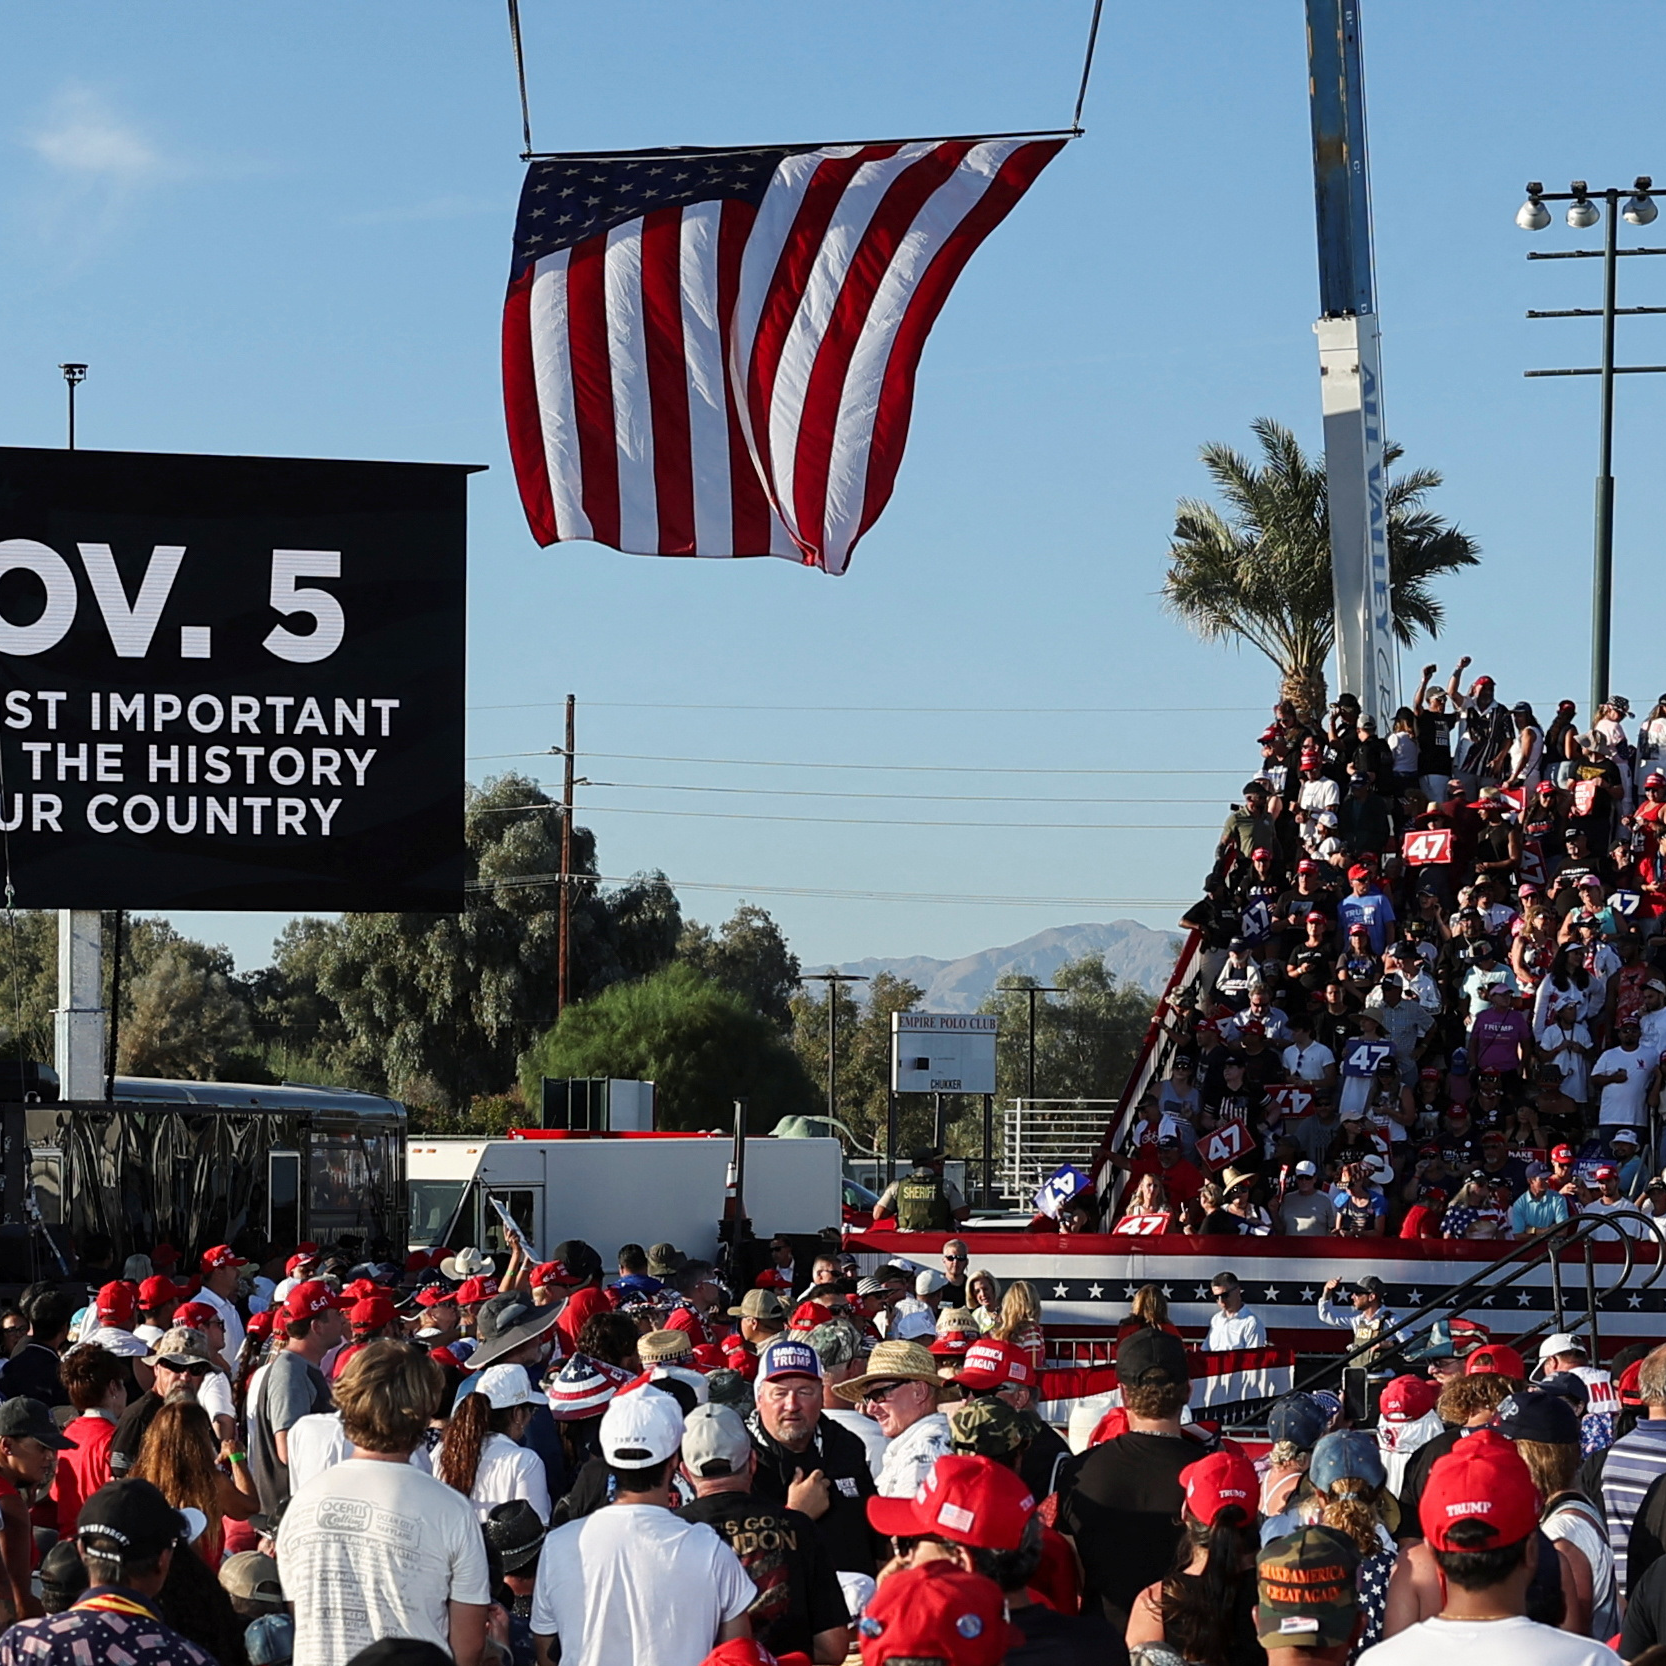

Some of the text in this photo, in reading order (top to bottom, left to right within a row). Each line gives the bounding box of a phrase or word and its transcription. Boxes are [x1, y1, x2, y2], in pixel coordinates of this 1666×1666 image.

[261, 549, 344, 664] 5
[91, 693, 400, 737] IMPORTANT
[22, 742, 122, 783] THE
[148, 744, 377, 787] HISTORY
[86, 794, 342, 836] COUNTRY
[1407, 833, 1447, 860] 47
[1241, 903, 1270, 938] 47
[1349, 1045, 1391, 1071] 47
[1208, 1124, 1240, 1161] 47
[1117, 1216, 1163, 1235] 47
[772, 1347, 812, 1358] HAVASU
[772, 1356, 812, 1368] TRUMP
[1218, 1489, 1247, 1499] TRUMP
[322, 1501, 368, 1519] OCEANS
[1445, 1501, 1492, 1518] TRUMP
[1261, 1562, 1346, 1585] MAKE AMERICA
[1266, 1583, 1340, 1602] GREAT AGAIN
